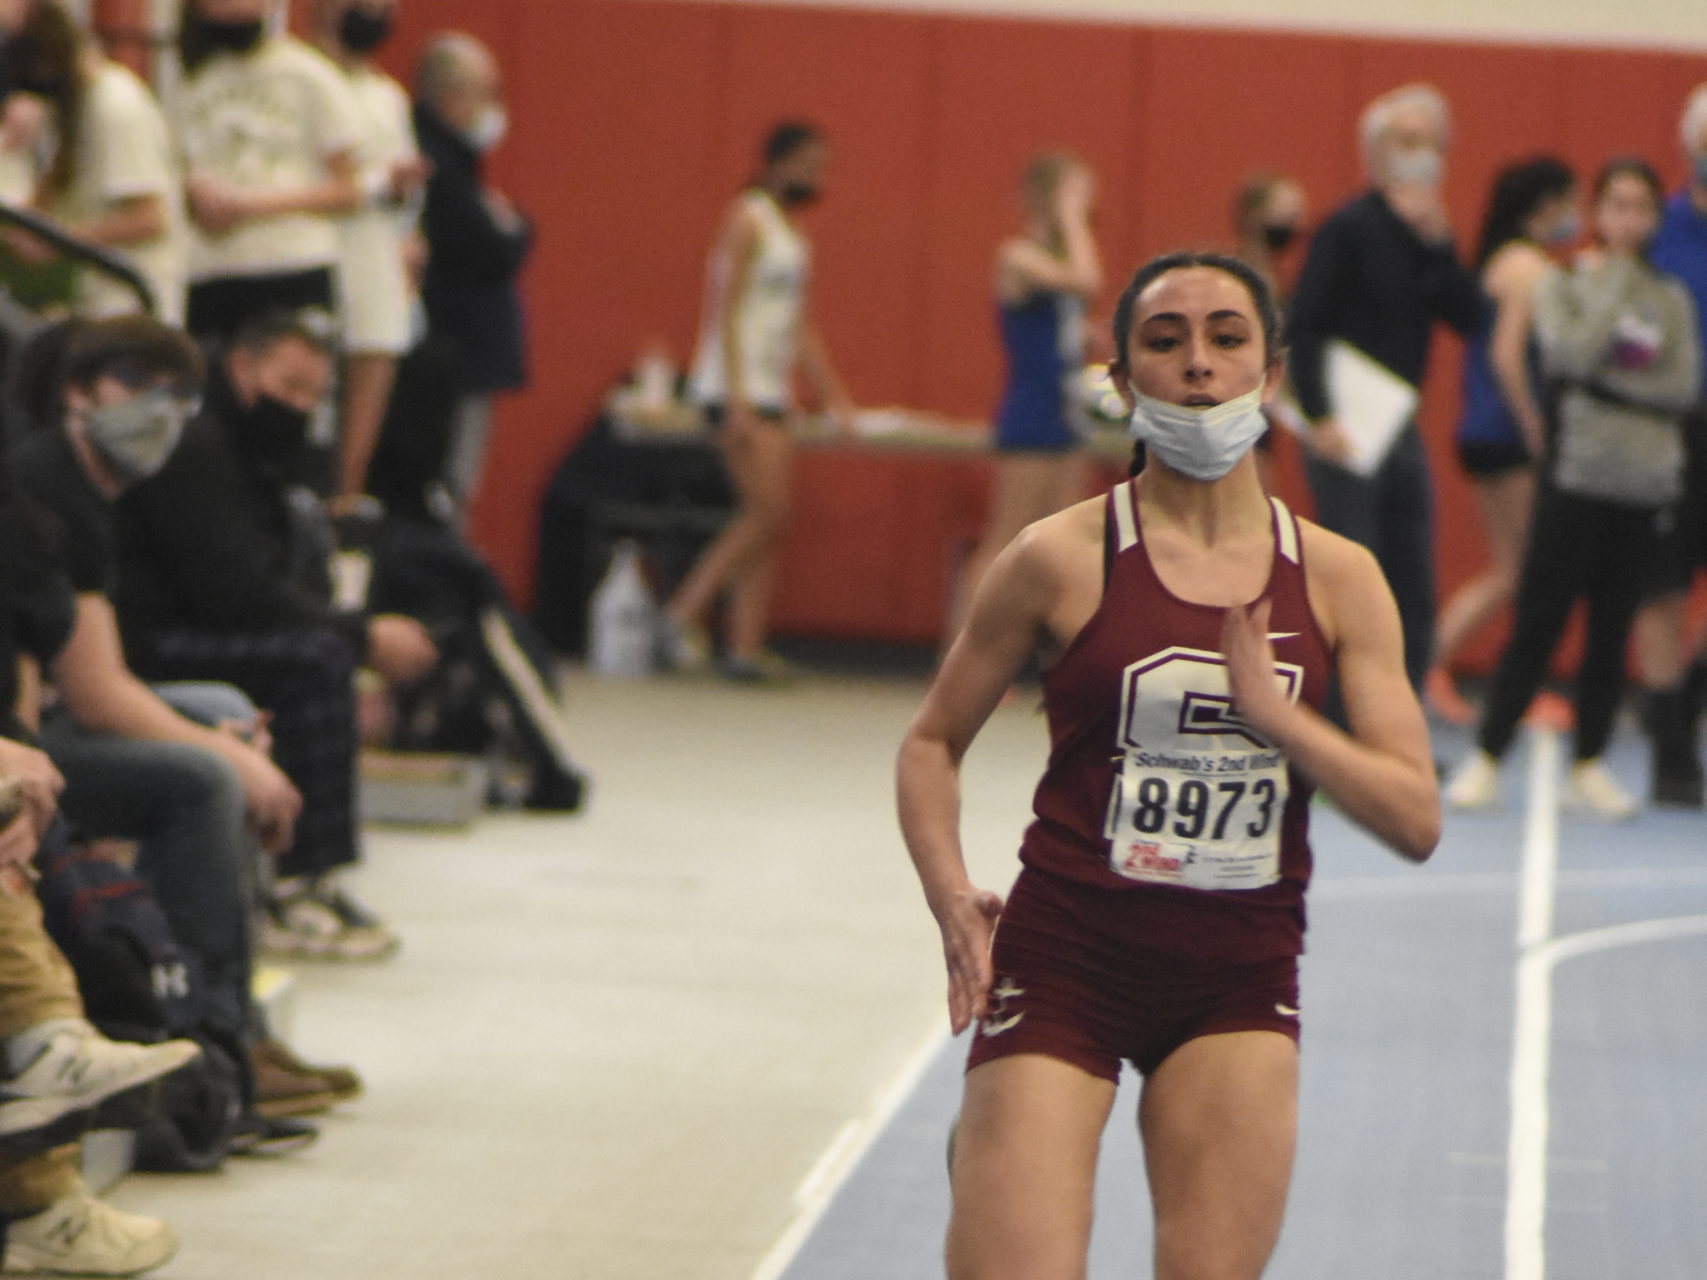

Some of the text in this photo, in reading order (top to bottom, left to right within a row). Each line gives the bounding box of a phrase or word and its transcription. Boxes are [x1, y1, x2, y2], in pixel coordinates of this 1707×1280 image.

[1135, 752, 1214, 773] Schwab's
[1217, 755, 1247, 772] 2nd
[1132, 777, 1276, 840] 8973
